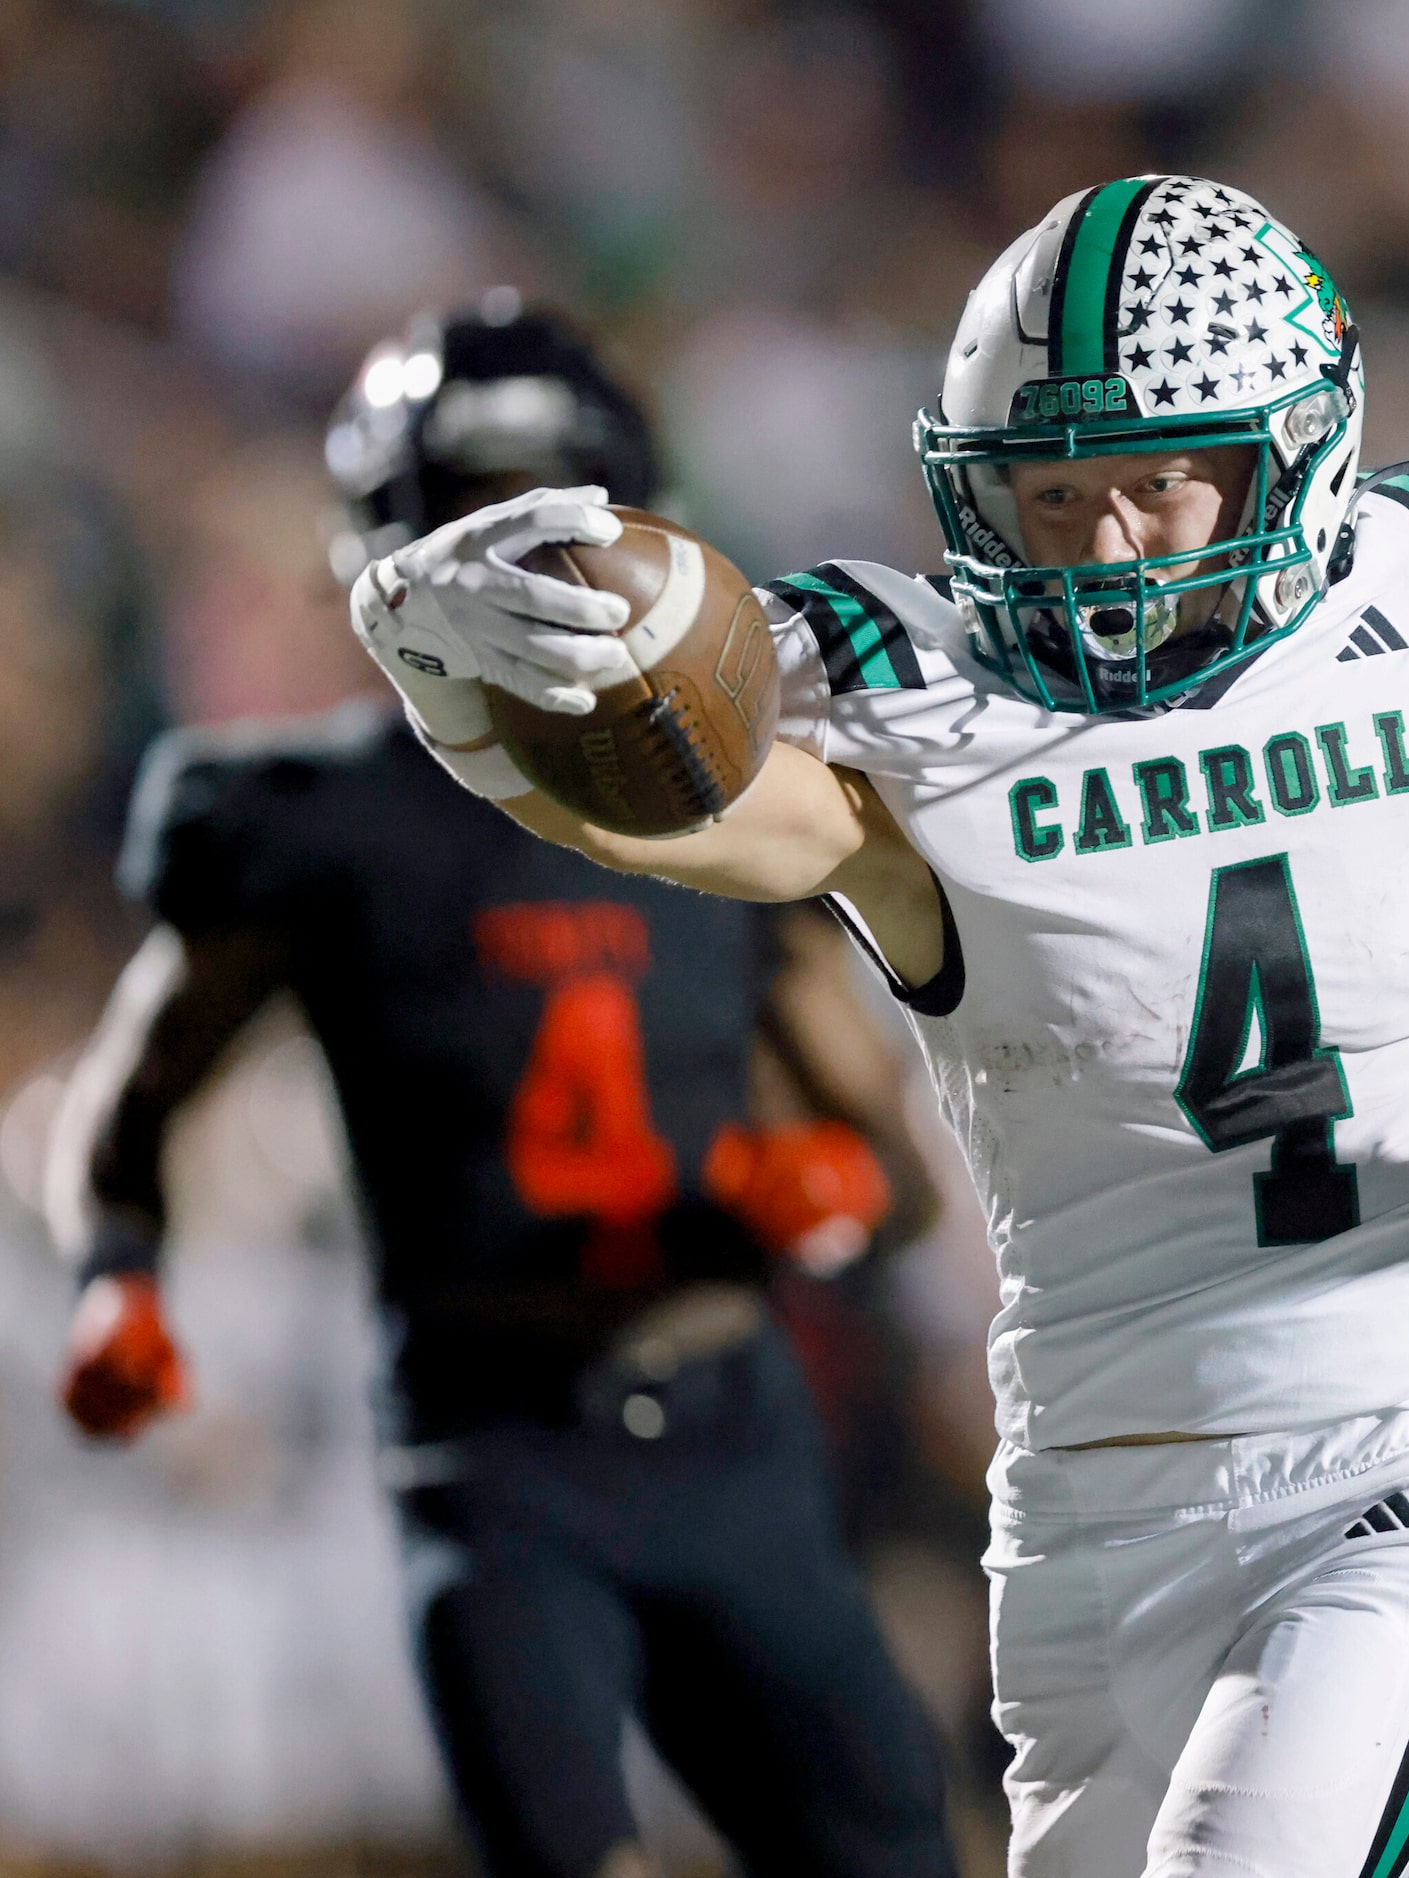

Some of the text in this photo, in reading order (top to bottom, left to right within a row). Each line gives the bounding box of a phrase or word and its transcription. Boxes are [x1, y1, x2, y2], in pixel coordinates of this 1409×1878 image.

[1020, 377, 1128, 419] 76092
[958, 506, 1022, 568] Ridde
[1228, 486, 1292, 568] Rell
[1100, 667, 1152, 683] Riddel
[1174, 852, 1361, 1248] 4
[506, 971, 677, 1285] 4
